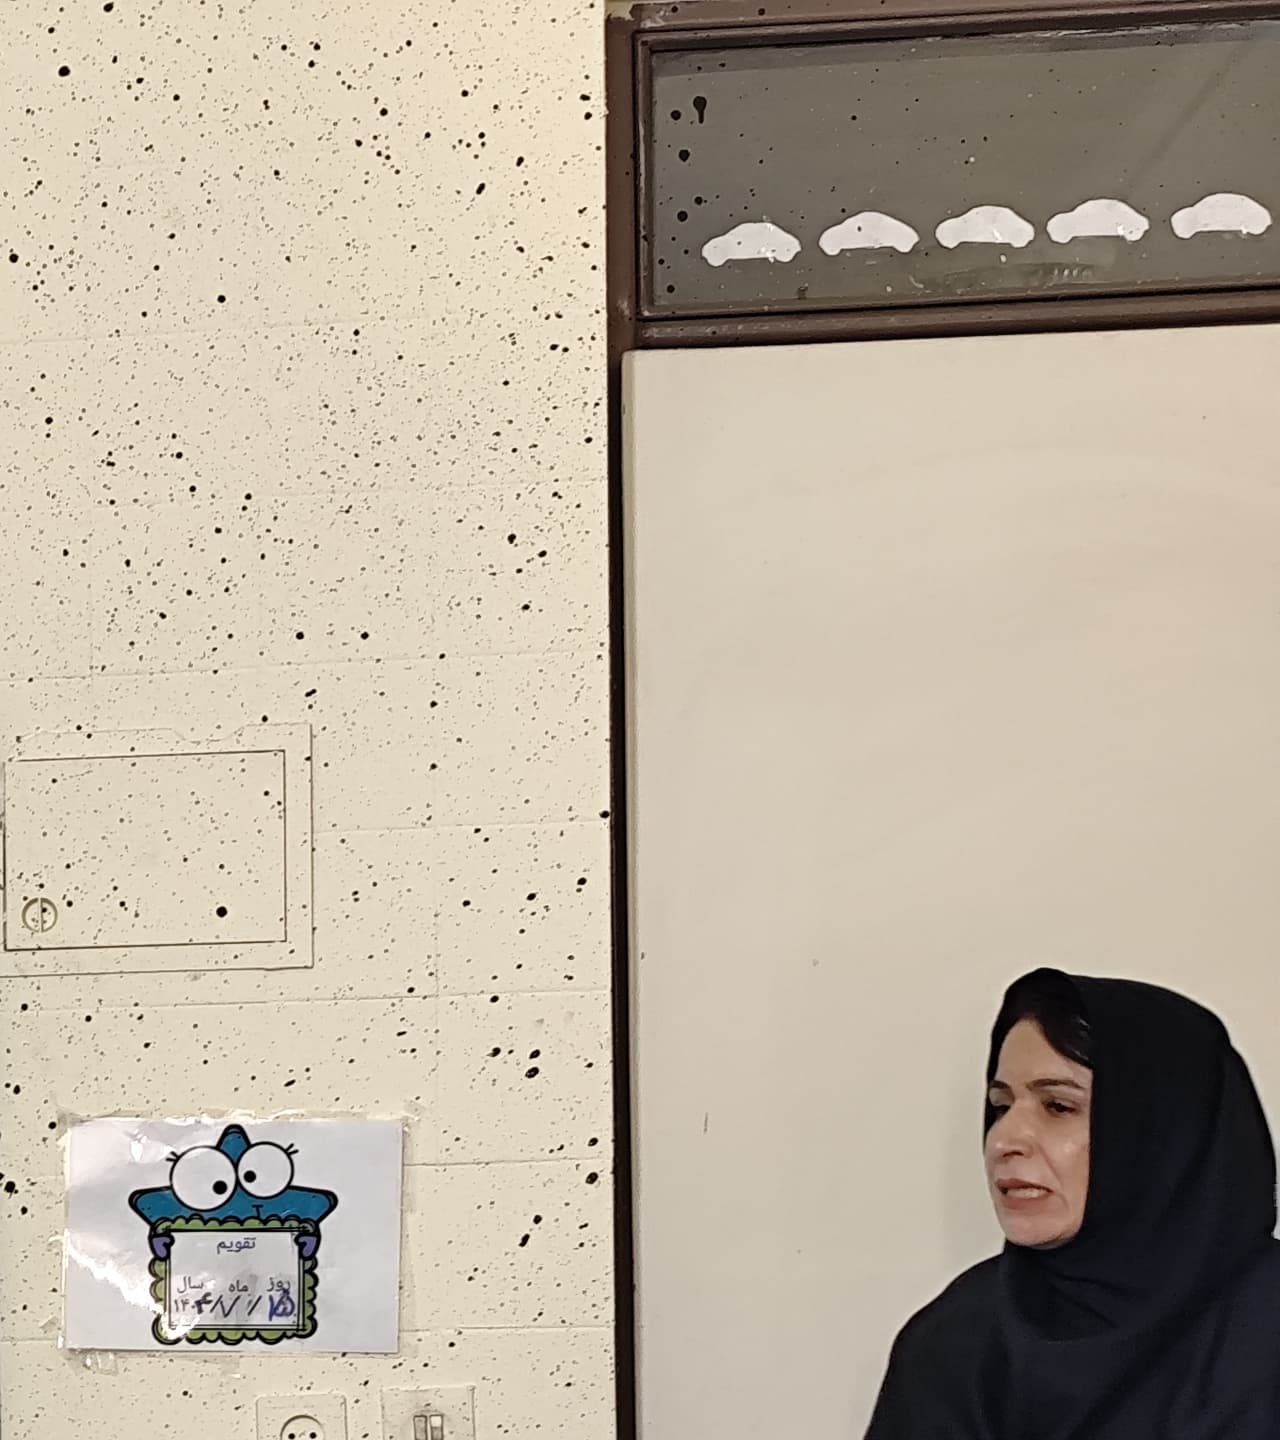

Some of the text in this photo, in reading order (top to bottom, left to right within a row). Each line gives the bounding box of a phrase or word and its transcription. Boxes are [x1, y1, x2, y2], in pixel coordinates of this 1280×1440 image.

[217, 1237, 256, 1254] تقویم
[178, 1276, 291, 1293] روز ماه سال
